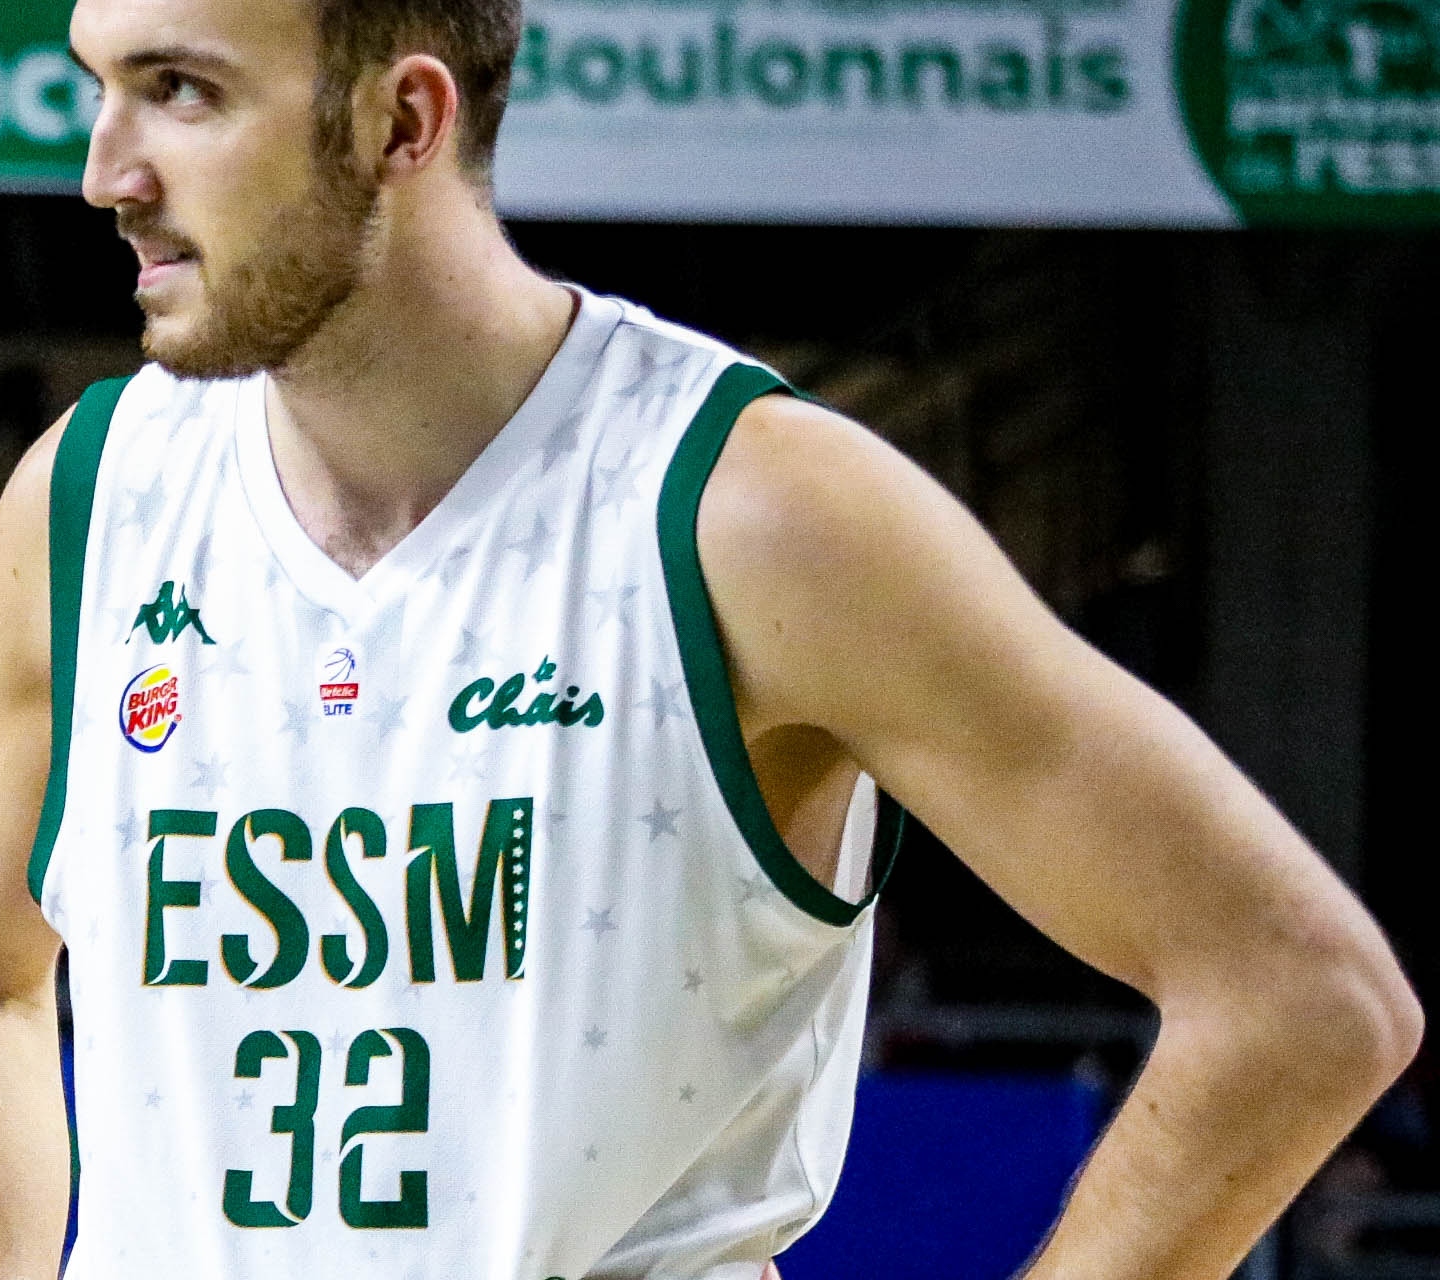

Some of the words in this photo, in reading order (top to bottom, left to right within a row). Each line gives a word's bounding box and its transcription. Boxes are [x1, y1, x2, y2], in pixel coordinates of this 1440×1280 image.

[127, 692, 178, 735] KING
[142, 797, 534, 991] ESSM
[222, 1027, 430, 1229] 32
